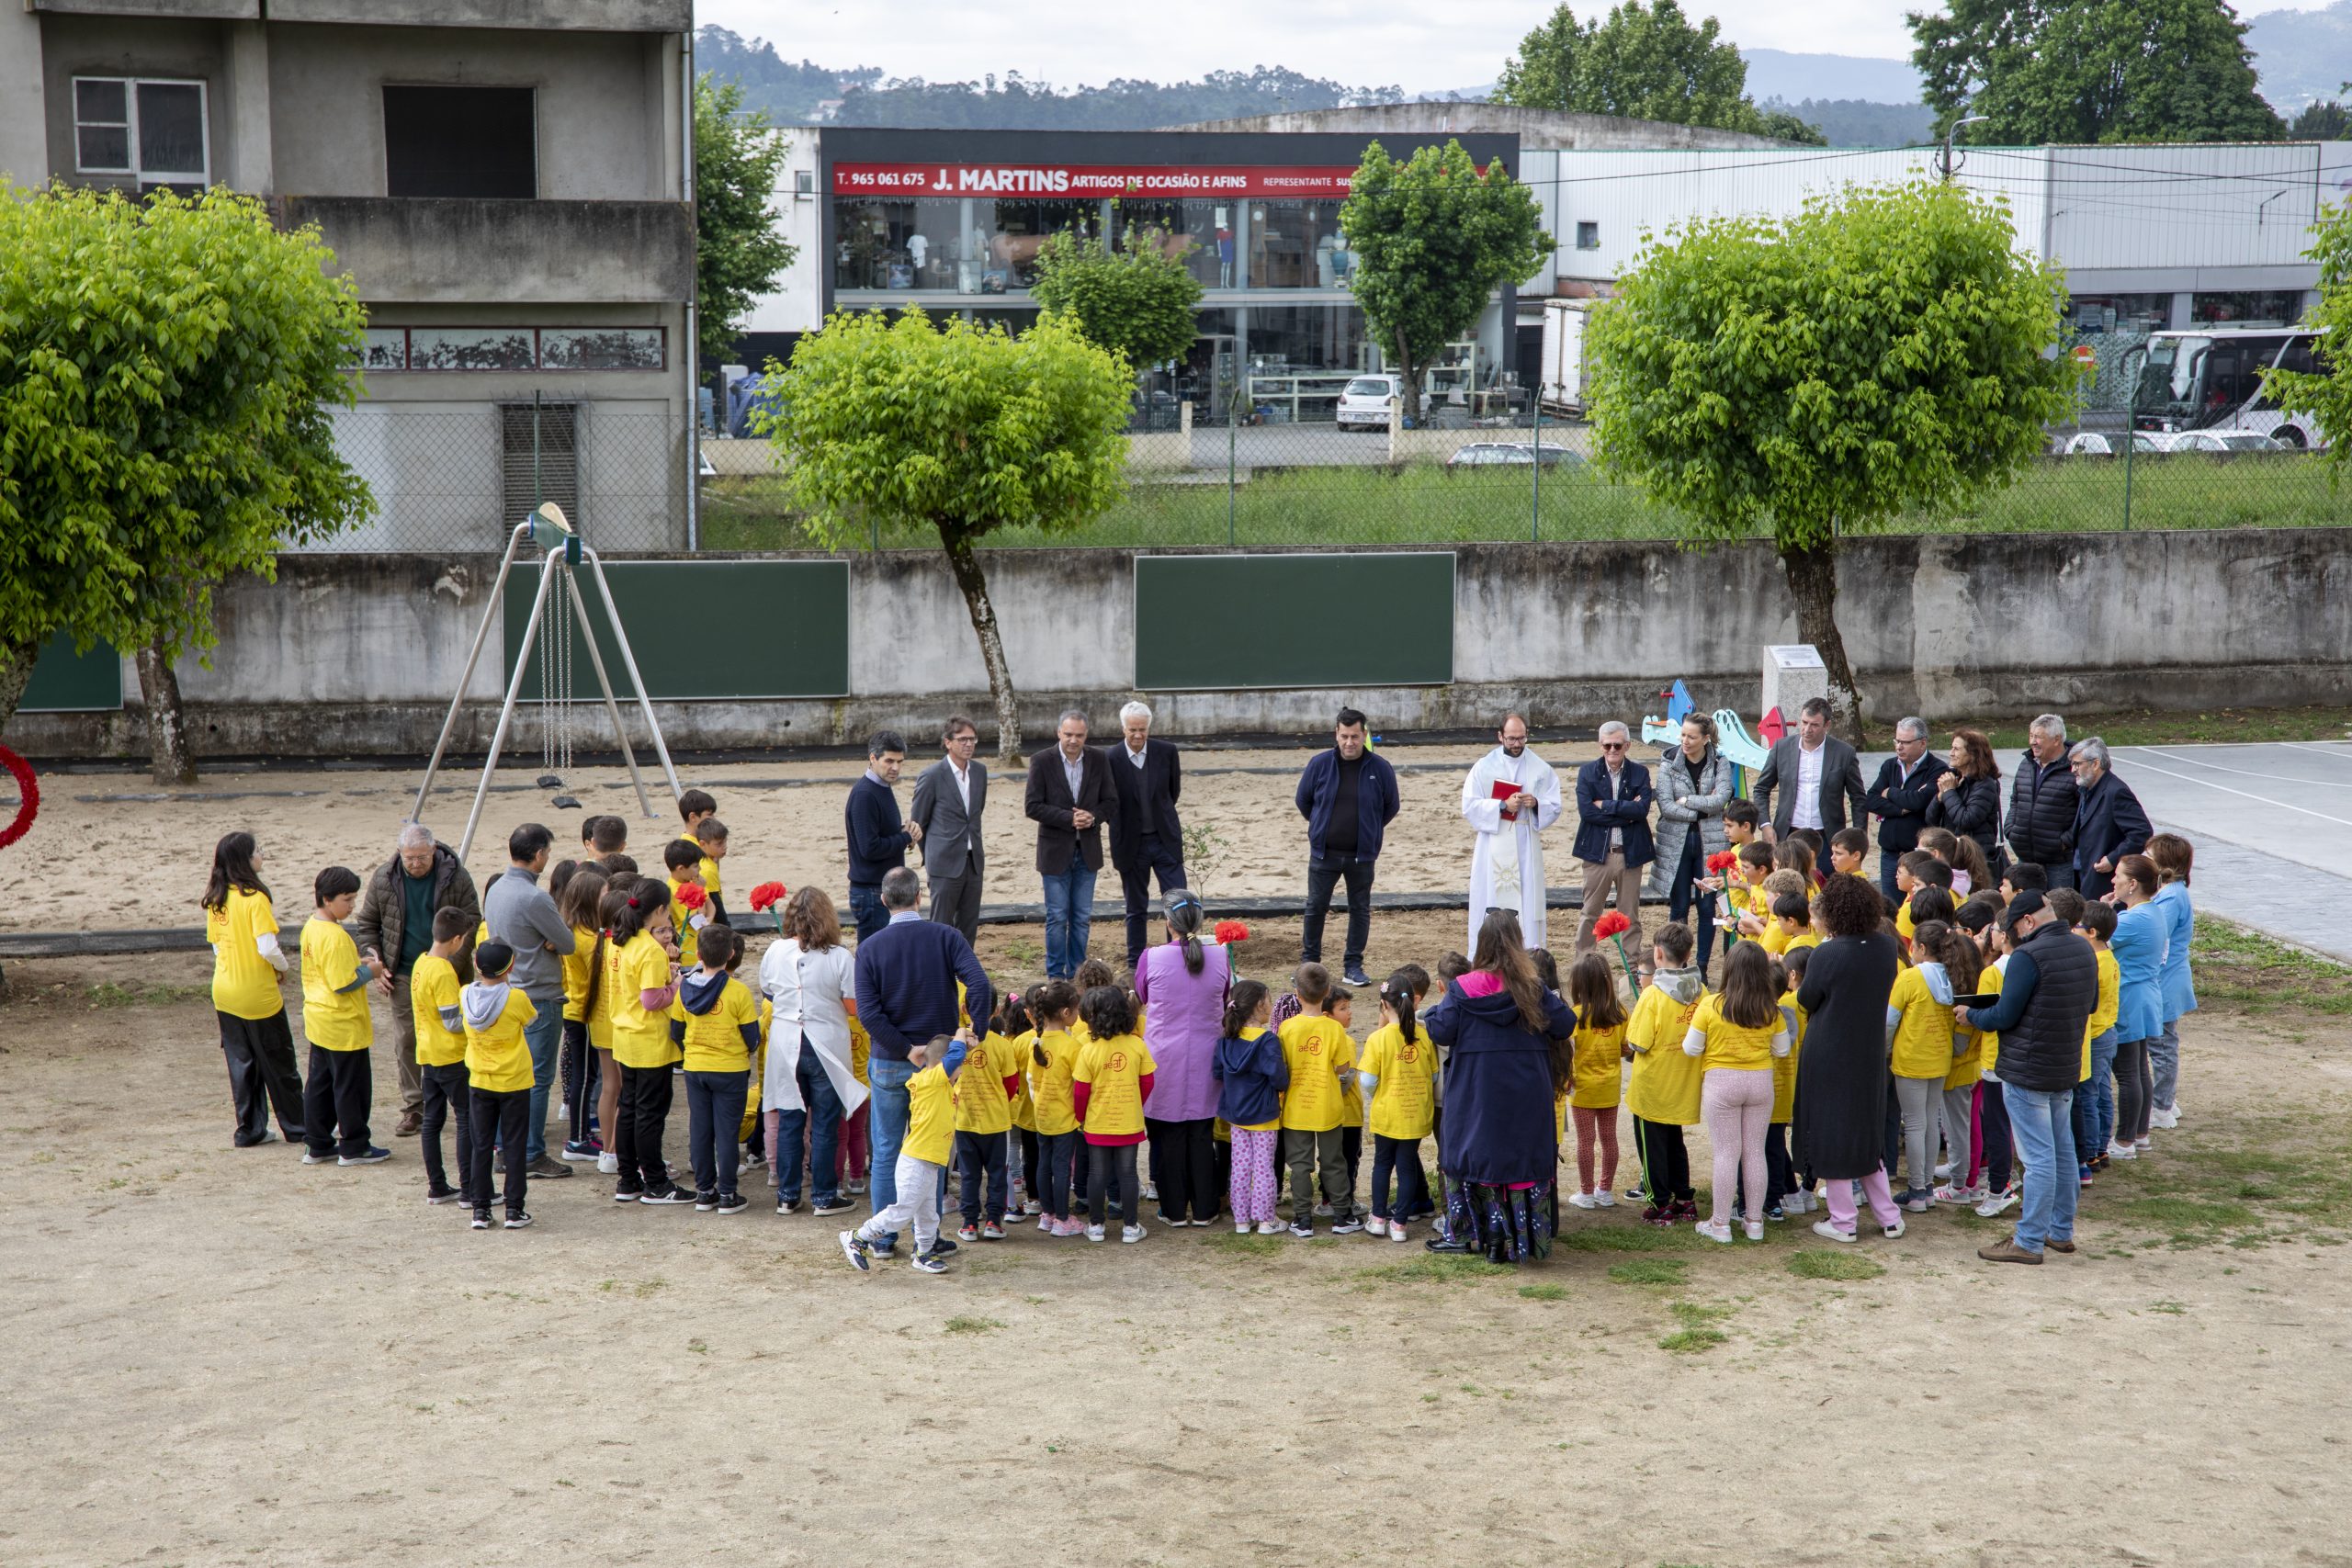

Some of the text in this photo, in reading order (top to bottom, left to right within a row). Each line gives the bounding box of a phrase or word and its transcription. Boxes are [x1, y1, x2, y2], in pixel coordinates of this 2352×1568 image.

[836, 172, 925, 186] T. 965 061 675
[932, 168, 1069, 192] J. MARTINS
[1070, 173, 1248, 189] ARTIGOS DE OCASIÃO E AFINS
[1263, 176, 1331, 187] REPRESENTANTE
